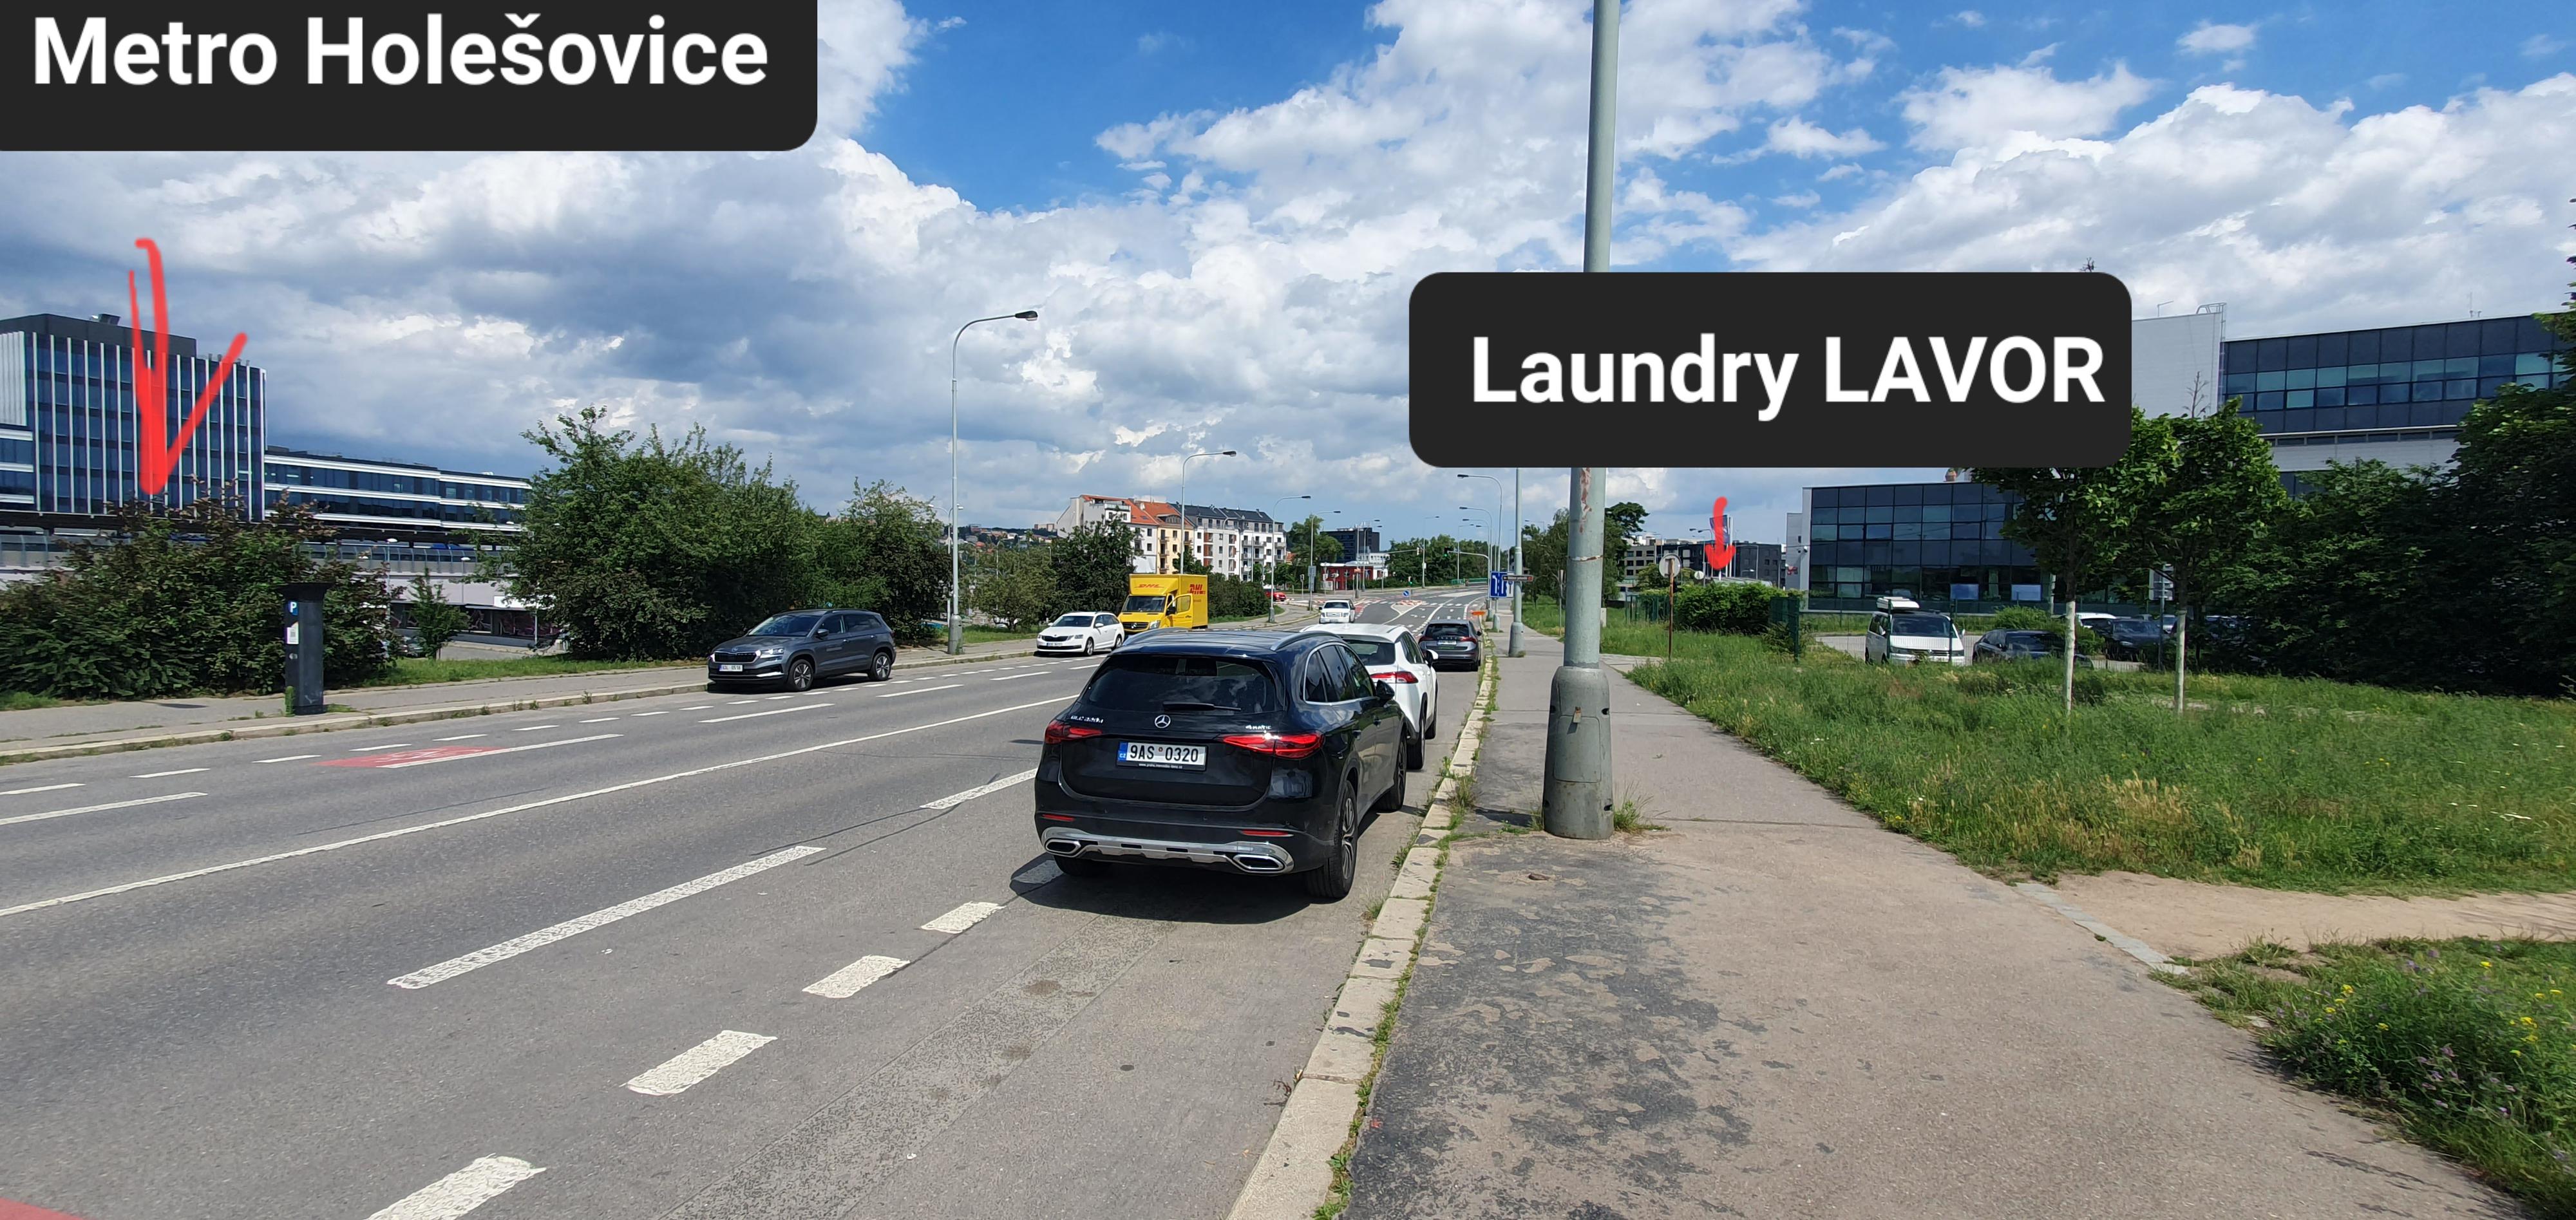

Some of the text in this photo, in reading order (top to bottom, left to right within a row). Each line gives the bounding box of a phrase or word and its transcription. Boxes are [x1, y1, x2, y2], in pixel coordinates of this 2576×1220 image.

[290, 601, 297, 613] P
[1130, 744, 1198, 763] 9AS 0320
